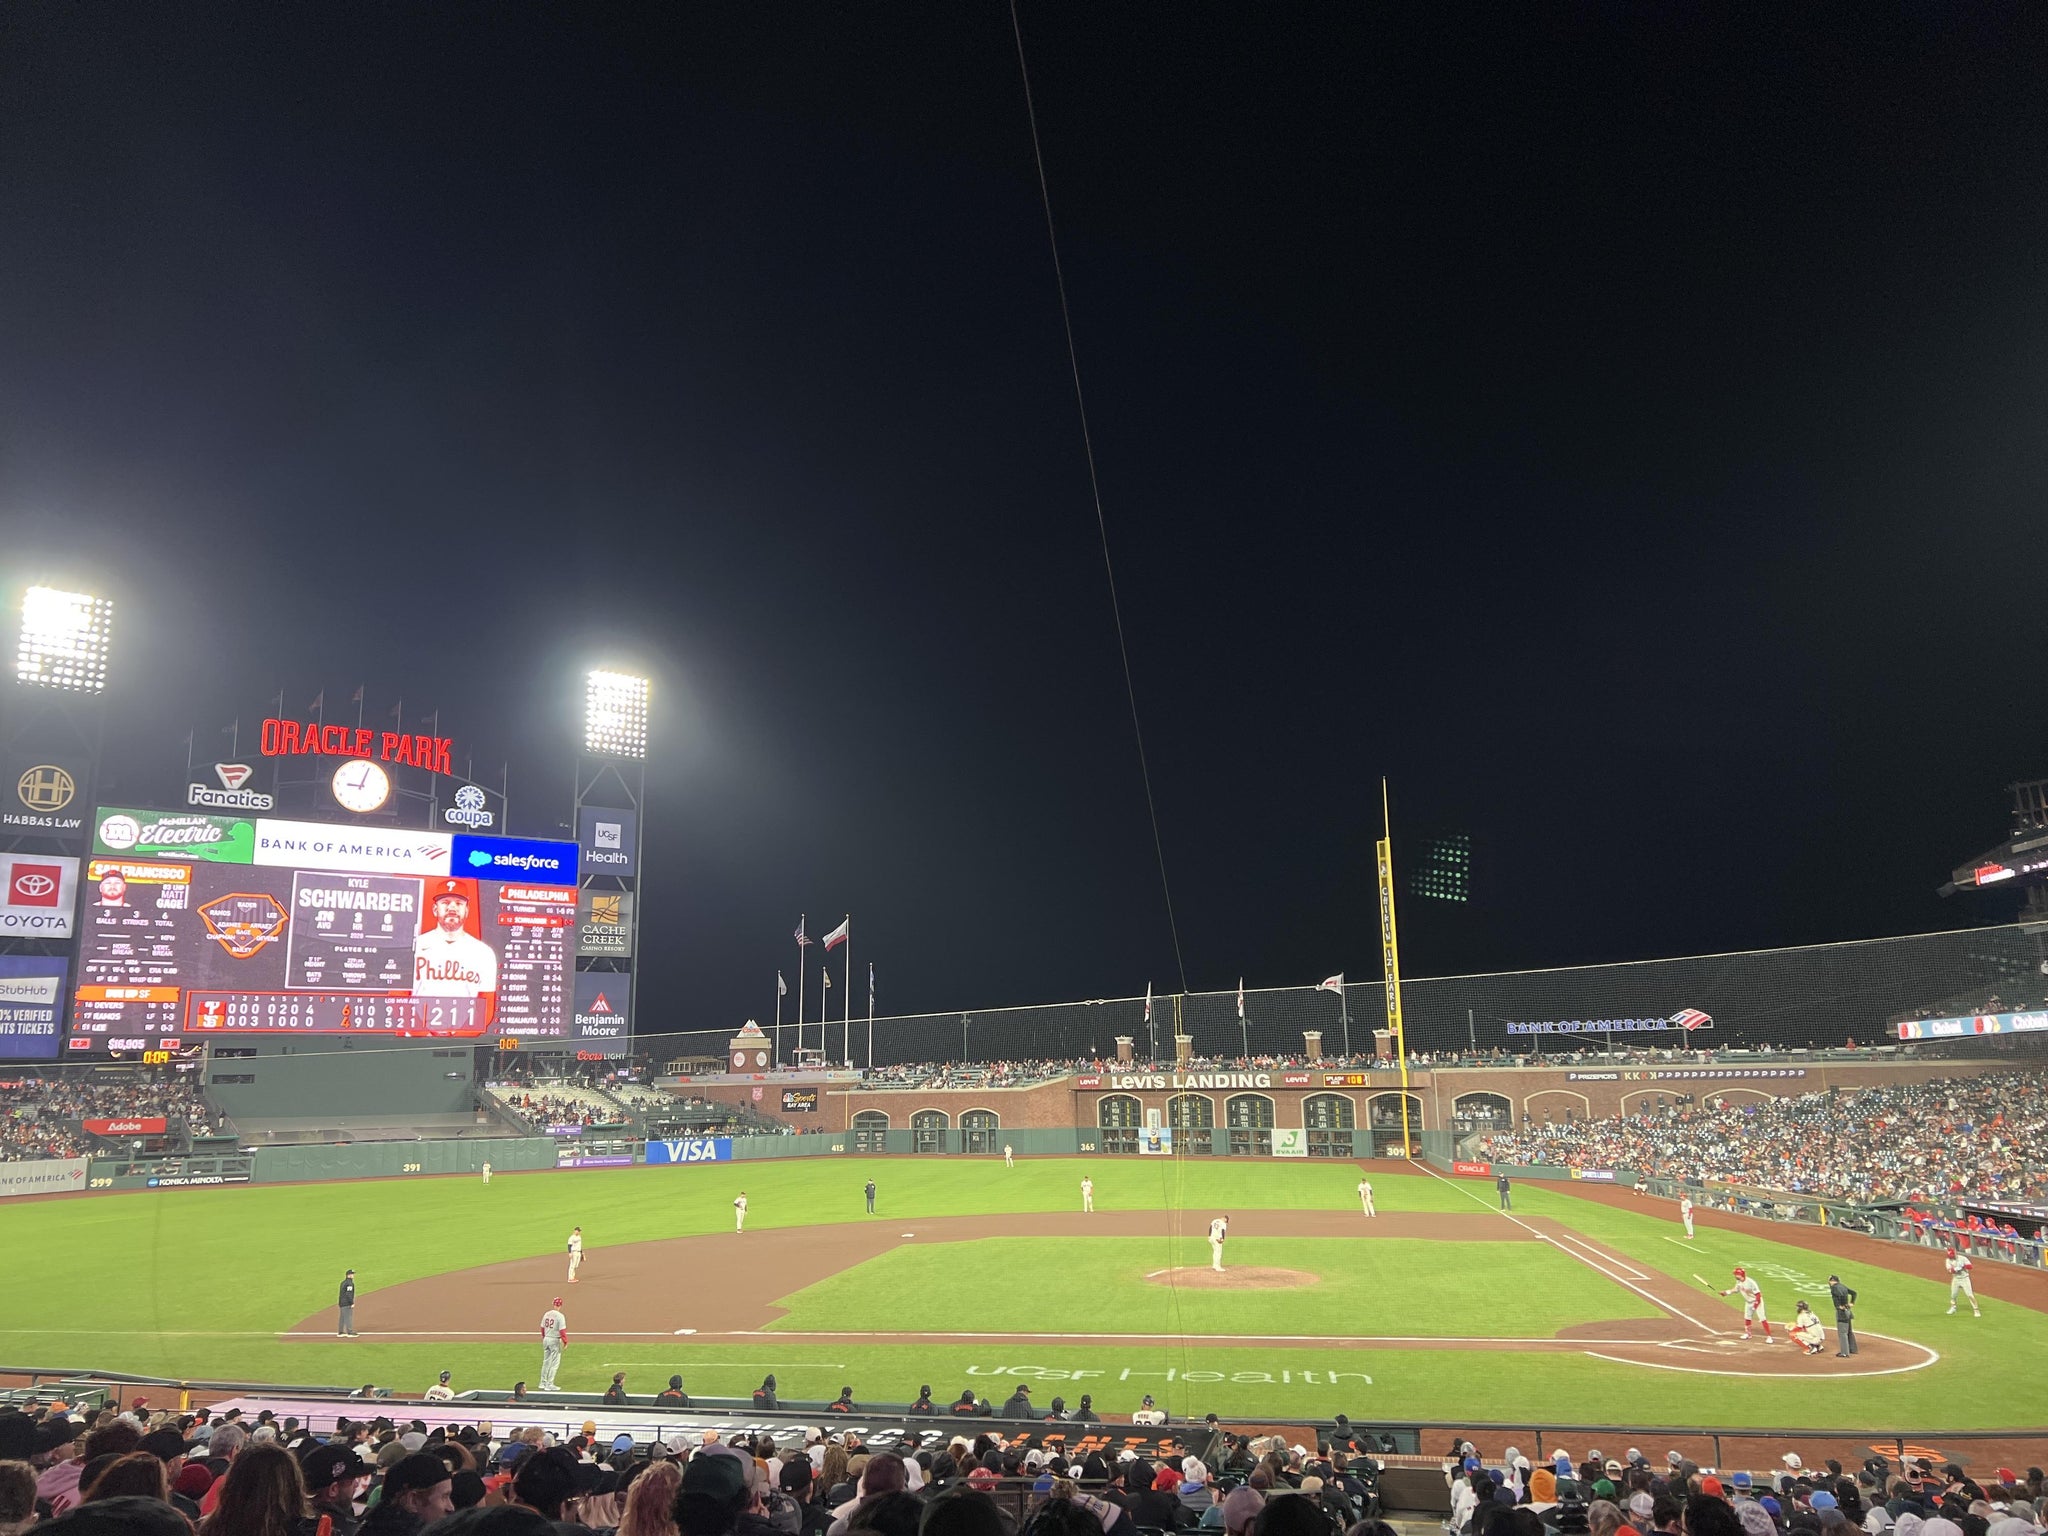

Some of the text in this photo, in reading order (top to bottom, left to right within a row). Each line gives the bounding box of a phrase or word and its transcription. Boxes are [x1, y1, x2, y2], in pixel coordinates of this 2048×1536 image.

[260, 718, 453, 775] ORACLE PARK
[192, 786, 270, 808] Fanatics
[3, 814, 81, 829] HABBAS LAW
[159, 817, 206, 826] McMILLAN
[447, 809, 491, 826] coupa
[139, 824, 222, 844] Electric
[598, 829, 618, 841] UCSF
[261, 838, 413, 858] BANK OF AMERICA
[494, 853, 559, 870] salesforce
[586, 850, 628, 864] Health
[121, 866, 185, 879] FRANCISCO
[348, 878, 369, 888] KYLE
[161, 890, 184, 899] MATT
[299, 888, 413, 912] SCHWARBER
[507, 889, 569, 901] PHILADELPHIA
[156, 898, 184, 909] GAGE
[1382, 887, 1391, 941] CHIKIN
[0, 915, 67, 928] TOYOTA
[582, 925, 626, 935] CACHE
[582, 935, 624, 945] CREEK
[1386, 948, 1393, 967] IZ
[415, 956, 480, 983] Phillies
[0, 985, 47, 995] StubHub
[139, 990, 151, 998] SF
[13, 1009, 52, 1021] VERIFIED
[228, 1003, 416, 1016] 0 0 0 0 2 0 4 6 11 0 9 1 1
[227, 1016, 415, 1028] 0 0 3 1 0 0 0 4 9 0 5 2 1
[430, 1007, 474, 1026] 2 1 1
[575, 1014, 624, 1026] Benjamin
[17, 1023, 54, 1034] TICKETS
[582, 1027, 617, 1036] Moore
[1507, 1018, 1667, 1034] BANK OF AMERICA
[107, 1038, 145, 1050] $16,905
[143, 1050, 169, 1064] 0:09
[576, 1049, 604, 1060] Coors
[1173, 1073, 1271, 1089] LANDING
[1625, 1072, 1632, 1080] K
[1633, 1072, 1640, 1080] K
[792, 1093, 816, 1102] Sports
[107, 1121, 142, 1131] Adobe
[663, 1141, 717, 1162] VISA
[831, 1144, 845, 1152] 415
[1387, 1147, 1405, 1157] 309
[403, 1163, 421, 1173] 391
[28, 1174, 66, 1183] AMERICA
[90, 1178, 113, 1187] 399
[159, 1176, 223, 1186] KONICA MINOLTA
[966, 1365, 1373, 1385] UCSF Health
